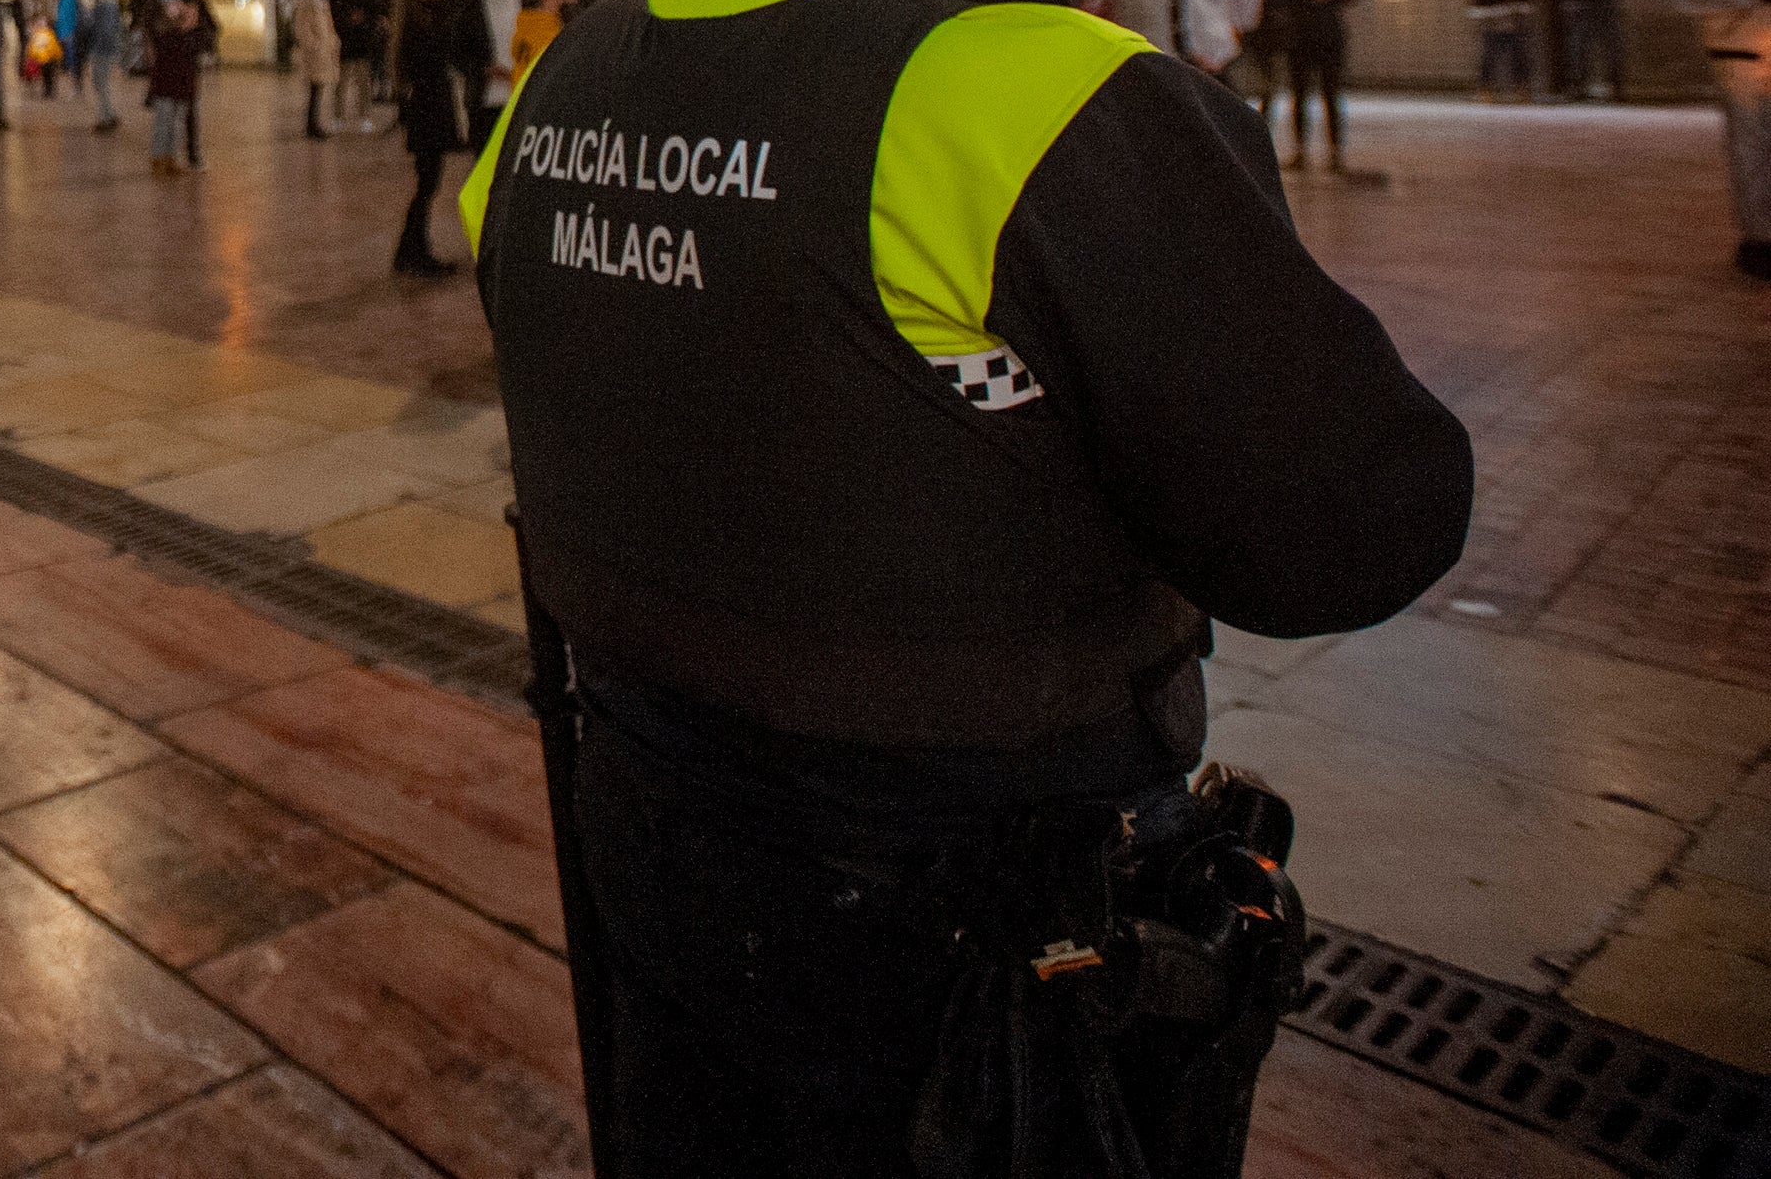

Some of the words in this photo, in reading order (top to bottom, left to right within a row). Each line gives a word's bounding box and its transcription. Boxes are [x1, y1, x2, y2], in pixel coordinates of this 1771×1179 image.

[513, 119, 627, 188] POLICÍA
[636, 134, 778, 200] LOCAL
[551, 203, 705, 290] MÁLAGA
